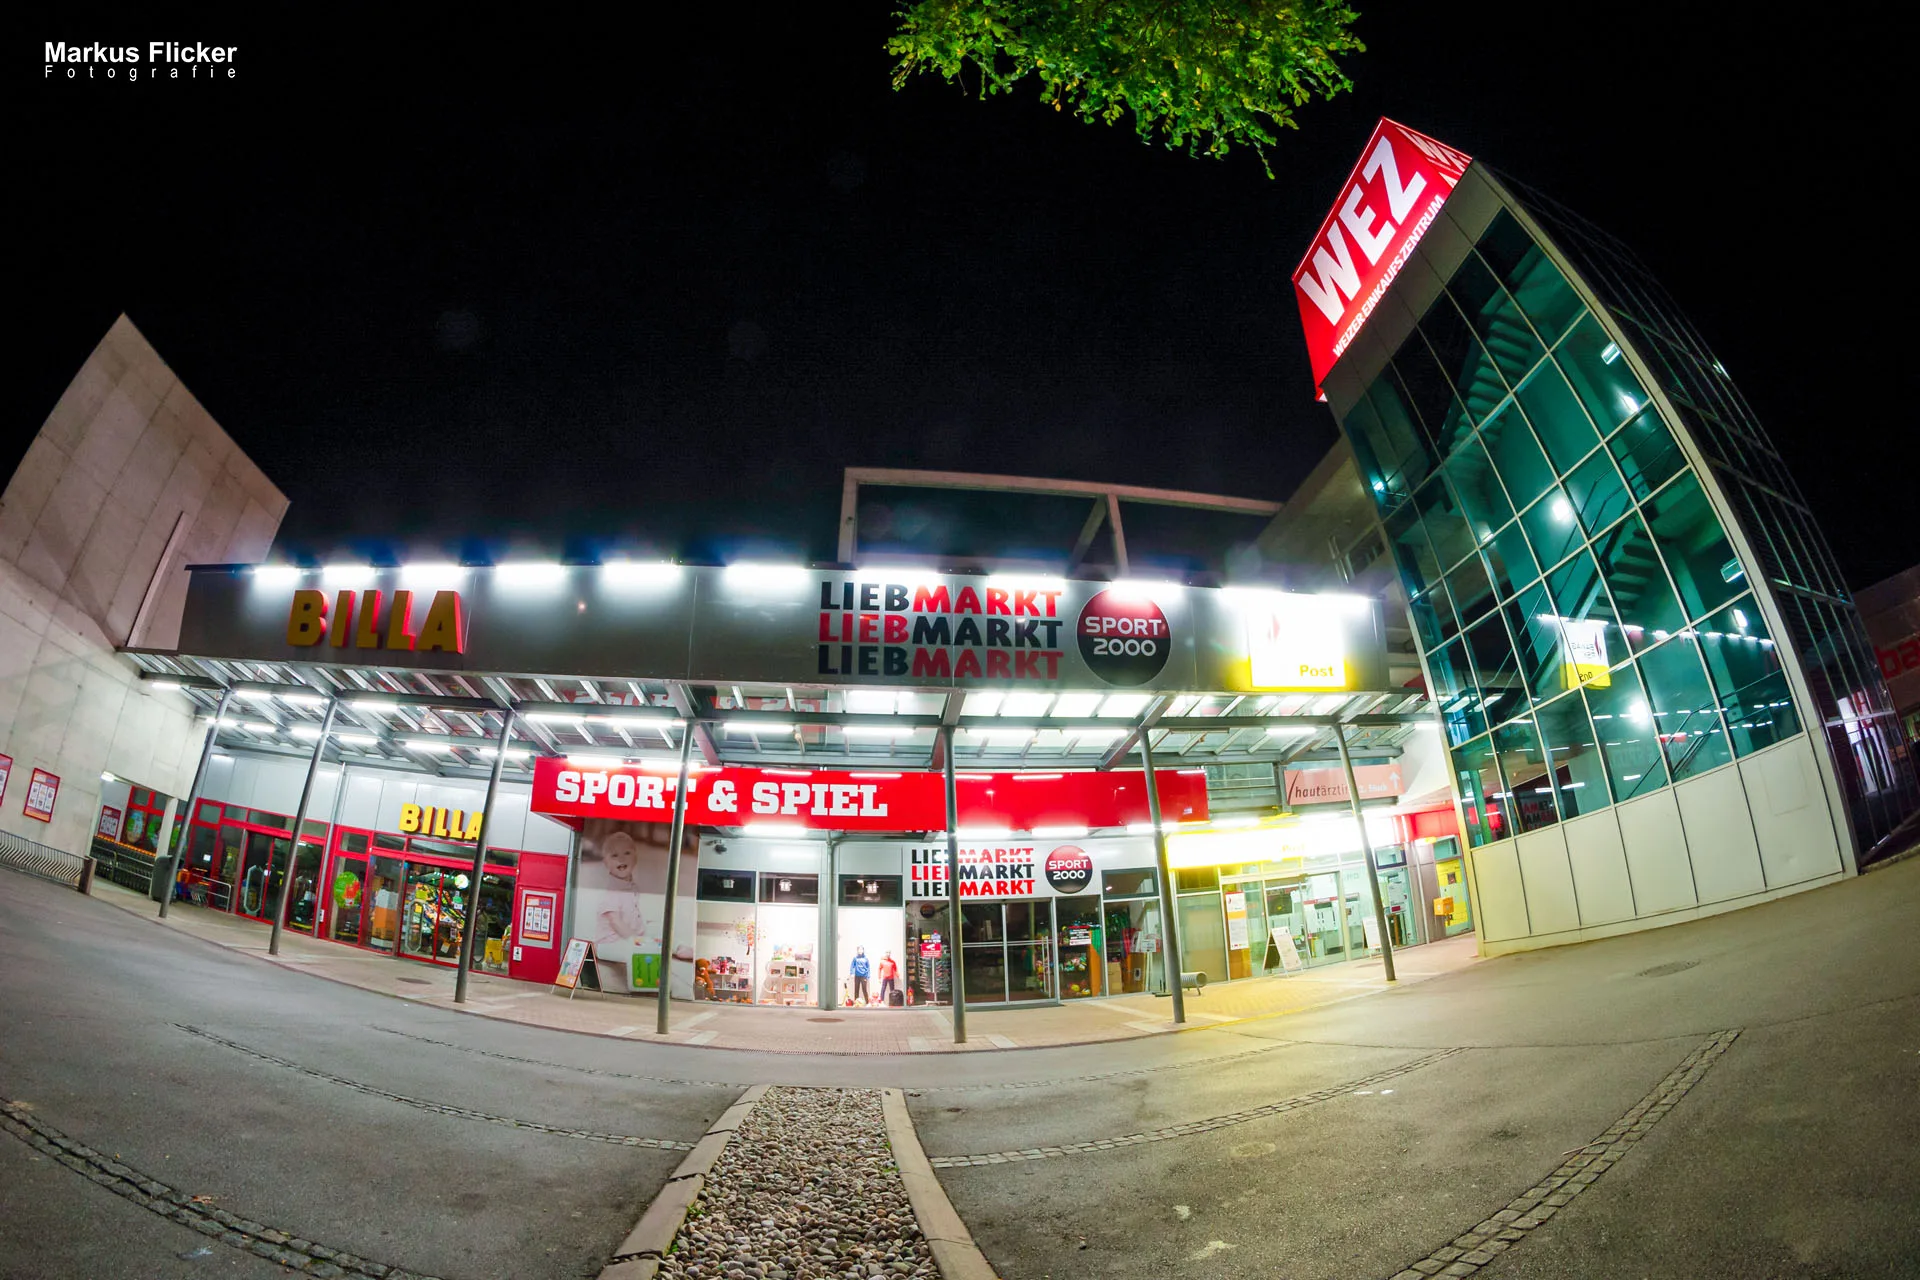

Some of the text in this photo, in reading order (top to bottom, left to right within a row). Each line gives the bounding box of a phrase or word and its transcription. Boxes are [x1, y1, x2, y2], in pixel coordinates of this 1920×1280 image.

[1298, 136, 1428, 326] WEZ
[1332, 313, 1366, 358] WEIZER
[821, 581, 1062, 617] LIEBMARKT
[287, 590, 462, 654] BILLA
[819, 612, 1063, 649] LIEBMARKT
[1085, 616, 1162, 636] SPORT
[818, 645, 1064, 680] LIEBMARKT
[1093, 638, 1157, 656] 2000
[1300, 665, 1334, 677] Post
[555, 771, 888, 817] SPORT & SPIEL
[1048, 859, 1089, 869] SPORT
[1052, 870, 1086, 880] 2000
